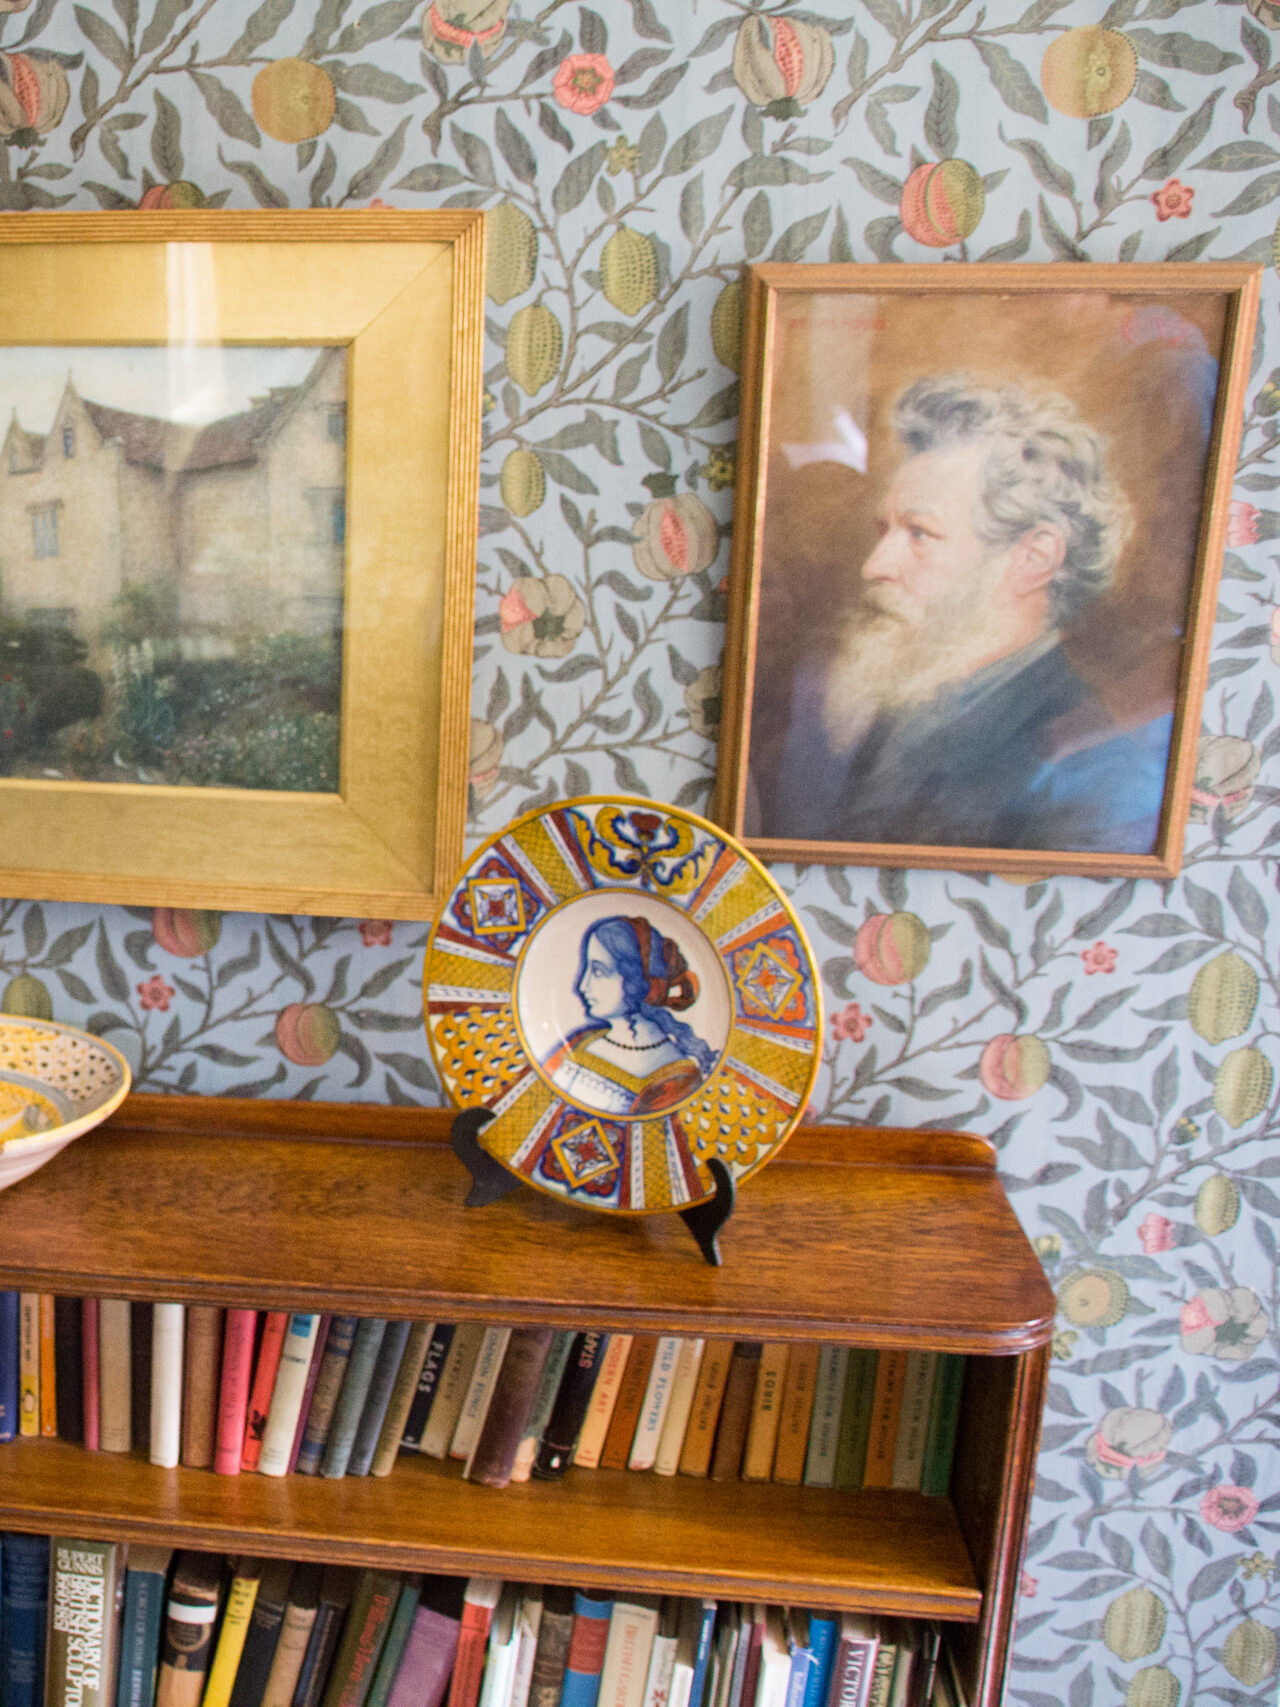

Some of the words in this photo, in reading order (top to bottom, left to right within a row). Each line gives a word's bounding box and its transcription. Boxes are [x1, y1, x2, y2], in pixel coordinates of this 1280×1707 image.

[419, 1341, 446, 1393] FLAGS
[661, 1339, 677, 1372] WILD
[596, 1392, 609, 1415] ART
[646, 1376, 667, 1432] FLOWERS
[68, 1573, 87, 1636] BRITISH
[83, 1576, 105, 1669] DICTIONARY
[82, 1668, 101, 1692] OF
